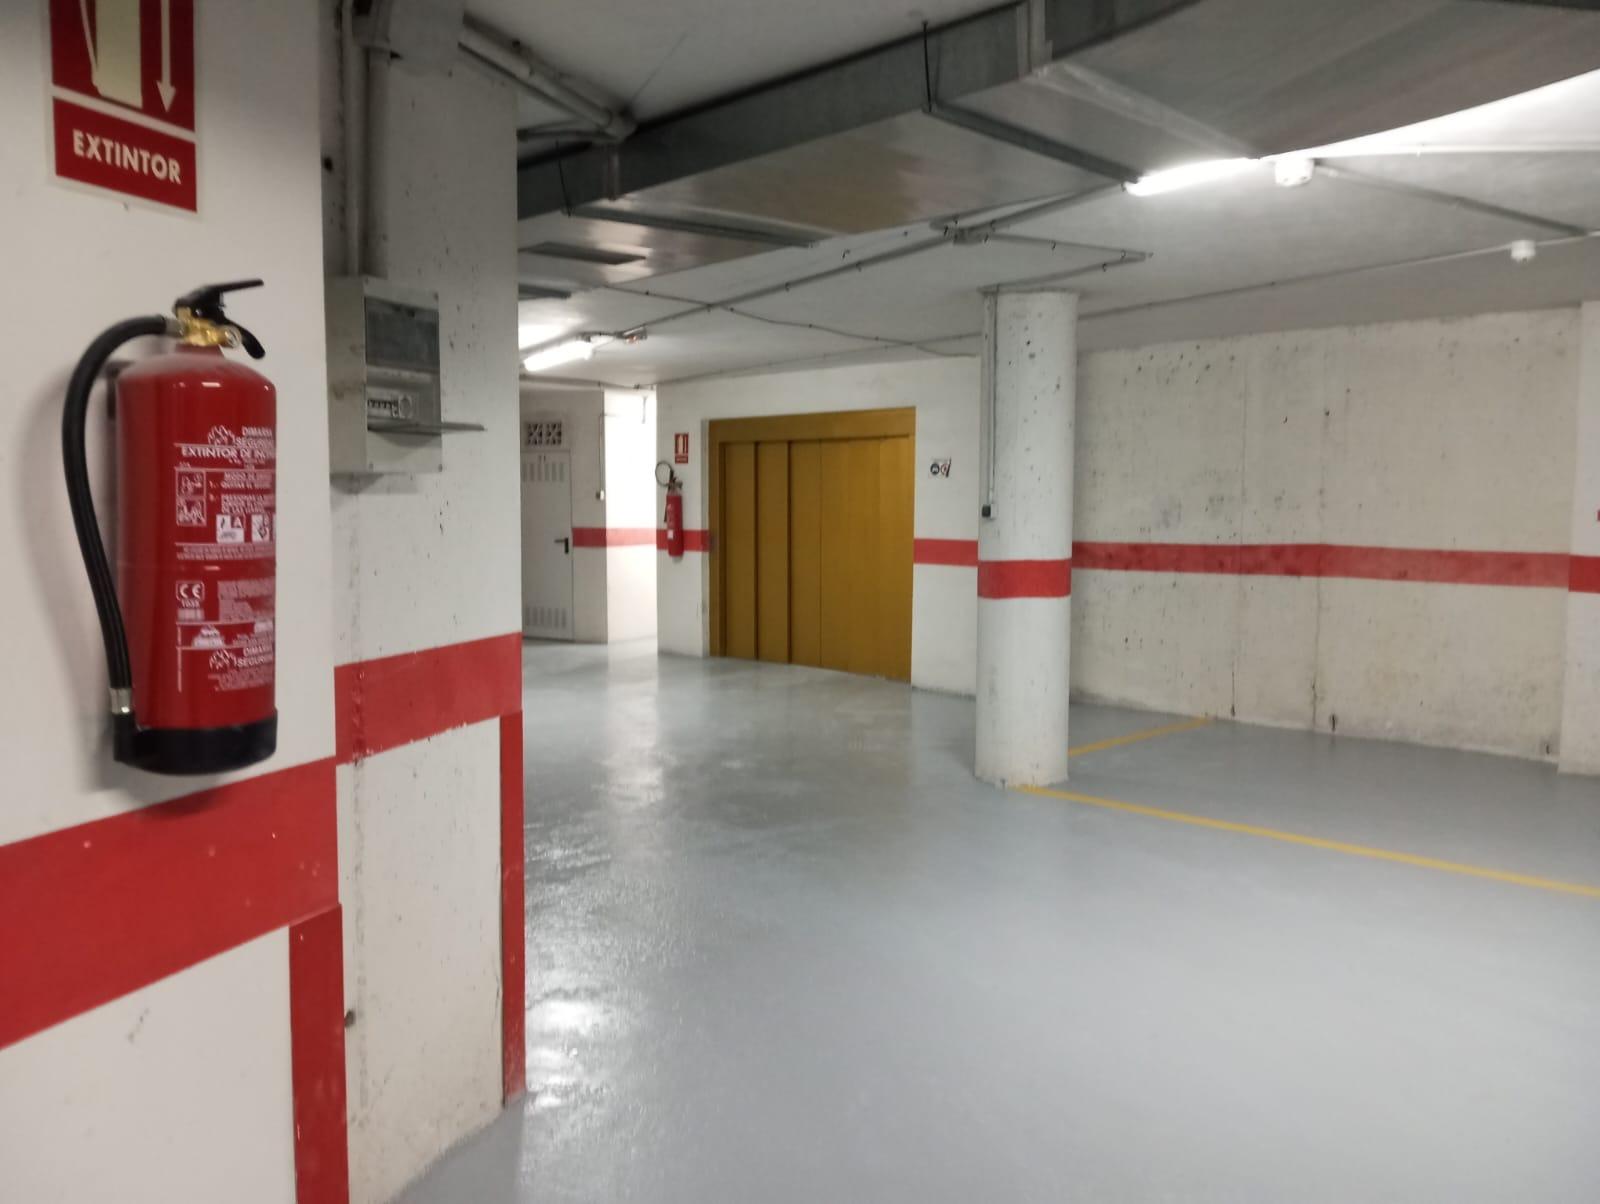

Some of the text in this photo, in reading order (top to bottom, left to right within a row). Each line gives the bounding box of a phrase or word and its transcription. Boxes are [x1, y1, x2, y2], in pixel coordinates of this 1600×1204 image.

[73, 128, 182, 185] EXTINTOR
[181, 446, 238, 459] EXTINTOR
[180, 583, 201, 599] CE
